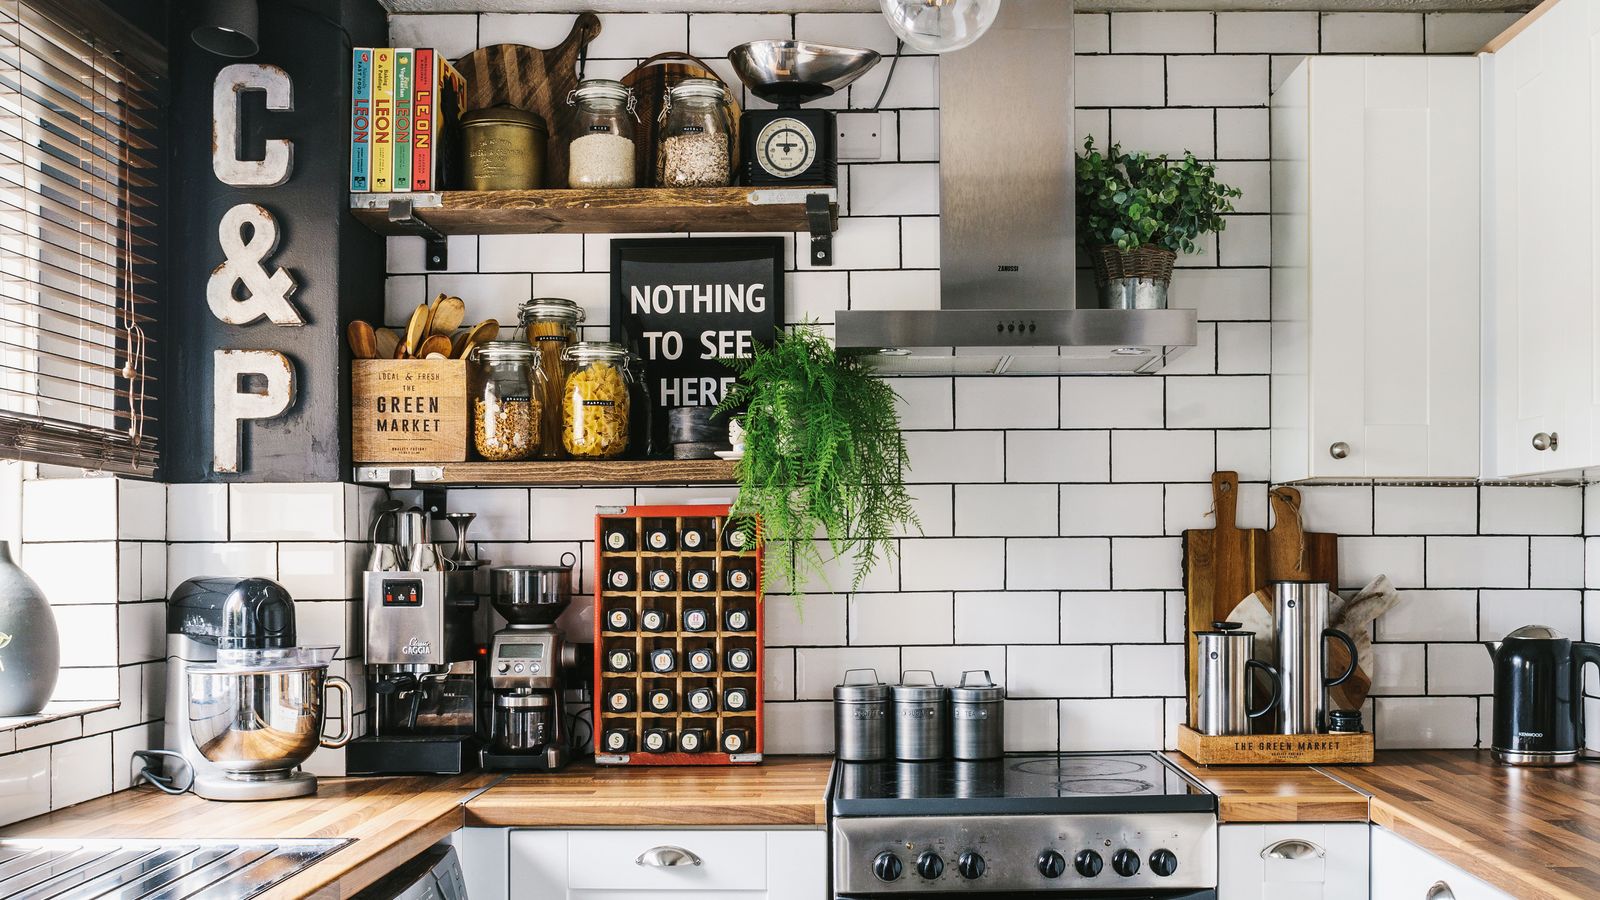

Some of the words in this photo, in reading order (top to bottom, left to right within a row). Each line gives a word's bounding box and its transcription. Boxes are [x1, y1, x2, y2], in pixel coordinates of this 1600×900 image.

[212, 63, 294, 187] C
[353, 99, 369, 143] LEON
[375, 99, 390, 143] LEON
[395, 99, 410, 143] LEON
[416, 90, 430, 149] LEON
[206, 203, 306, 327] &
[630, 283, 766, 314] NOTHING
[643, 331, 683, 360] TO
[700, 330, 752, 360] SEE
[378, 373, 400, 381] LOCAL
[405, 373, 413, 381] &
[418, 373, 440, 381] FRESH
[213, 349, 297, 473] P
[377, 396, 439, 413] GREEN
[377, 419, 440, 432] MARKET
[402, 646, 431, 655] GAGGIA
[964, 709, 976, 717] TEA
[1234, 742, 1253, 751] THE
[1258, 742, 1292, 751] GREEN
[1297, 742, 1340, 751] MARKET
